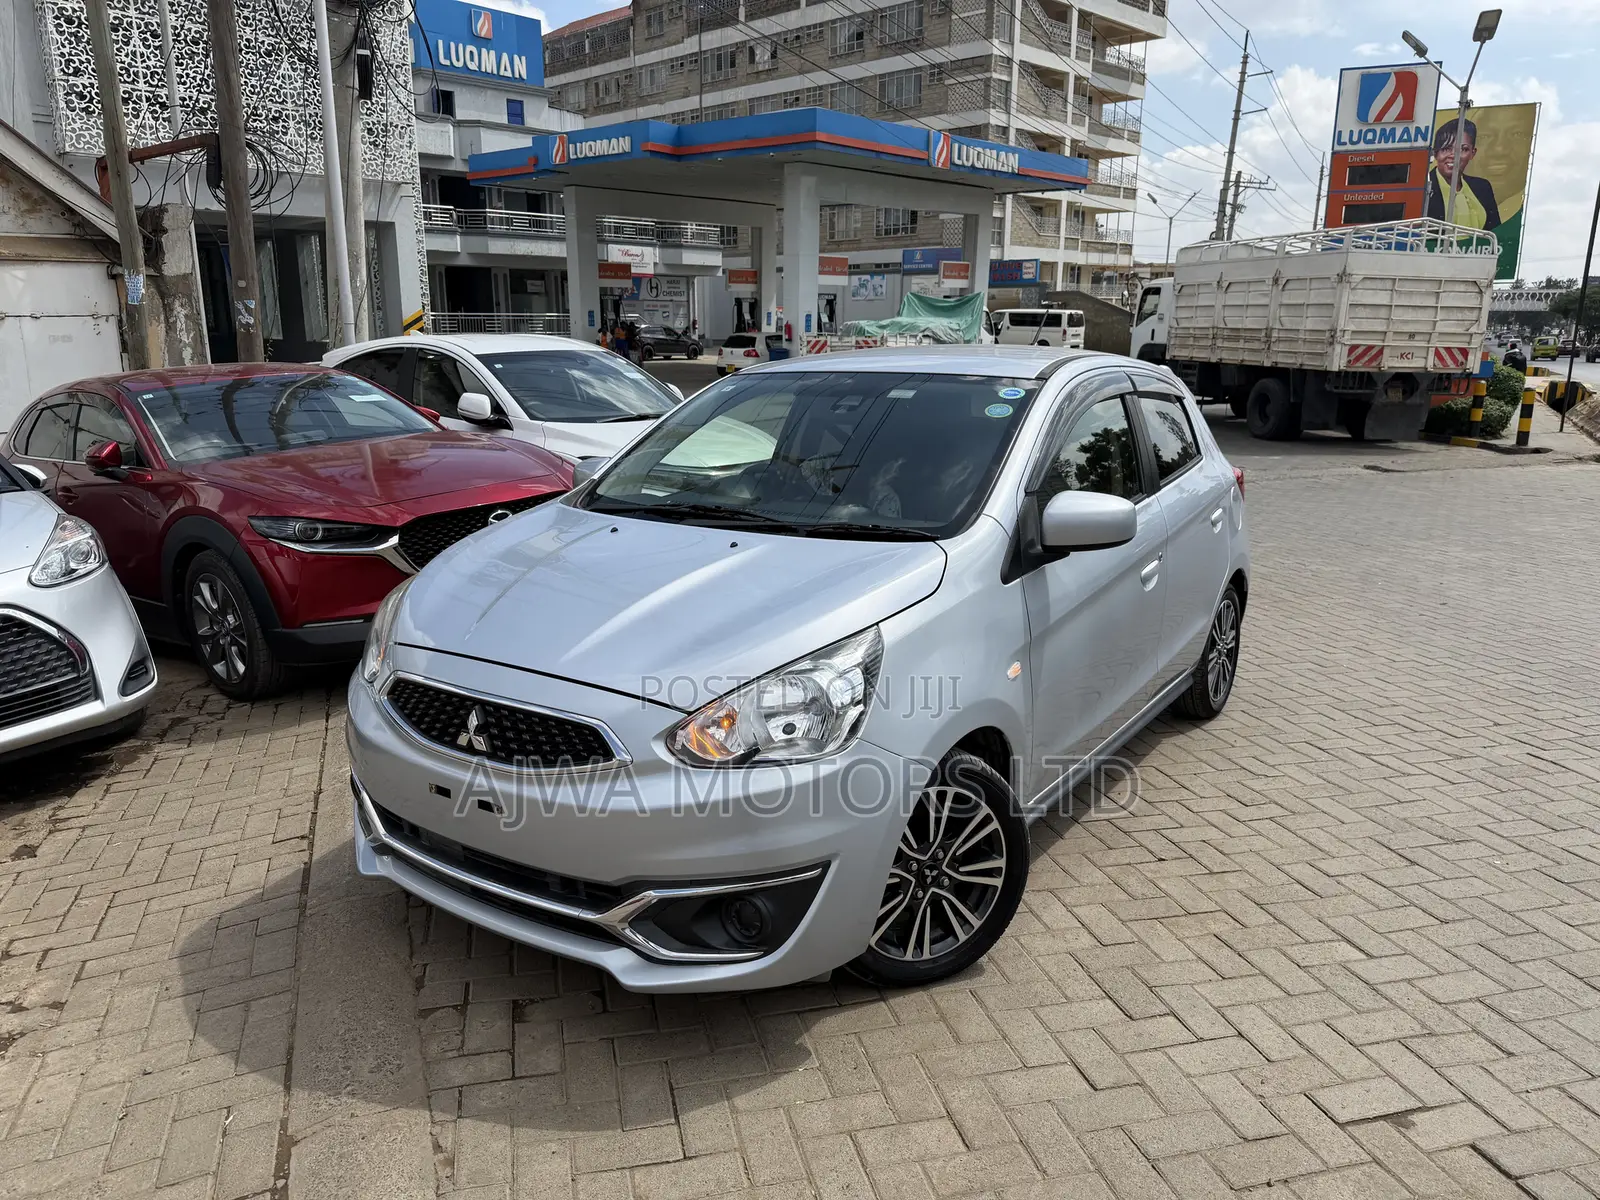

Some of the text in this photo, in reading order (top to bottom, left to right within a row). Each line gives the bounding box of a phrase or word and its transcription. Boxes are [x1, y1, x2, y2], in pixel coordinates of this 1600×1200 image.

[438, 39, 527, 80] LUQMAN
[1336, 125, 1430, 146] LUQMAN
[569, 136, 631, 159] LUQMAN
[952, 143, 1019, 173] LUQMAN
[1348, 154, 1375, 162] Diesel
[1343, 192, 1385, 201] Unleaded
